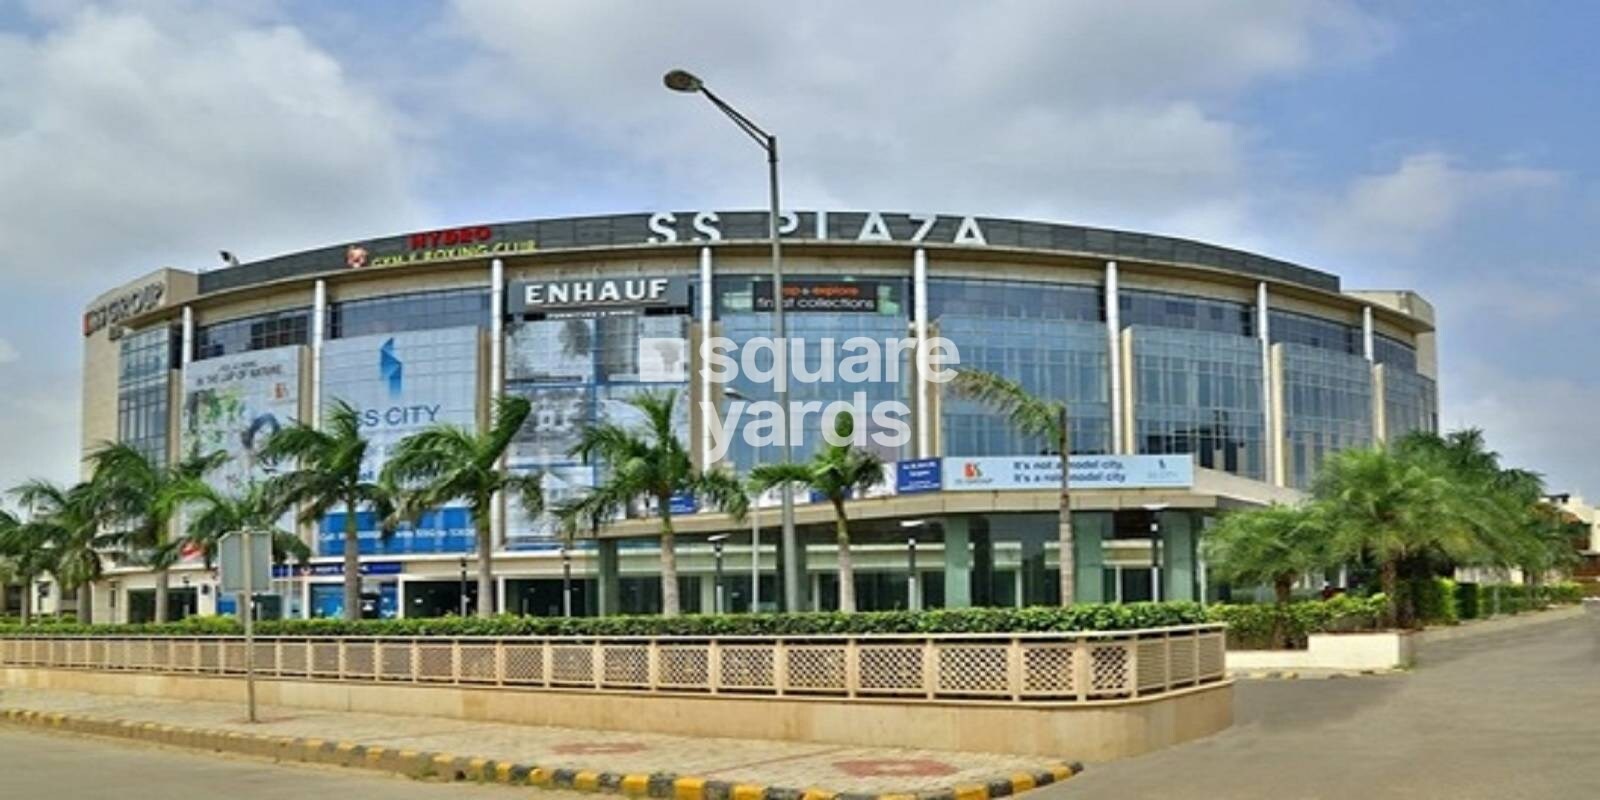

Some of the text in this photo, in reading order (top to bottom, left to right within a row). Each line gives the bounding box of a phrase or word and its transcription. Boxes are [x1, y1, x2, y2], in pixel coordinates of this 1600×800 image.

[648, 211, 722, 243] SS
[524, 277, 669, 305] ENHAUF
[798, 297, 875, 310] collections
[385, 403, 442, 426] CITY
